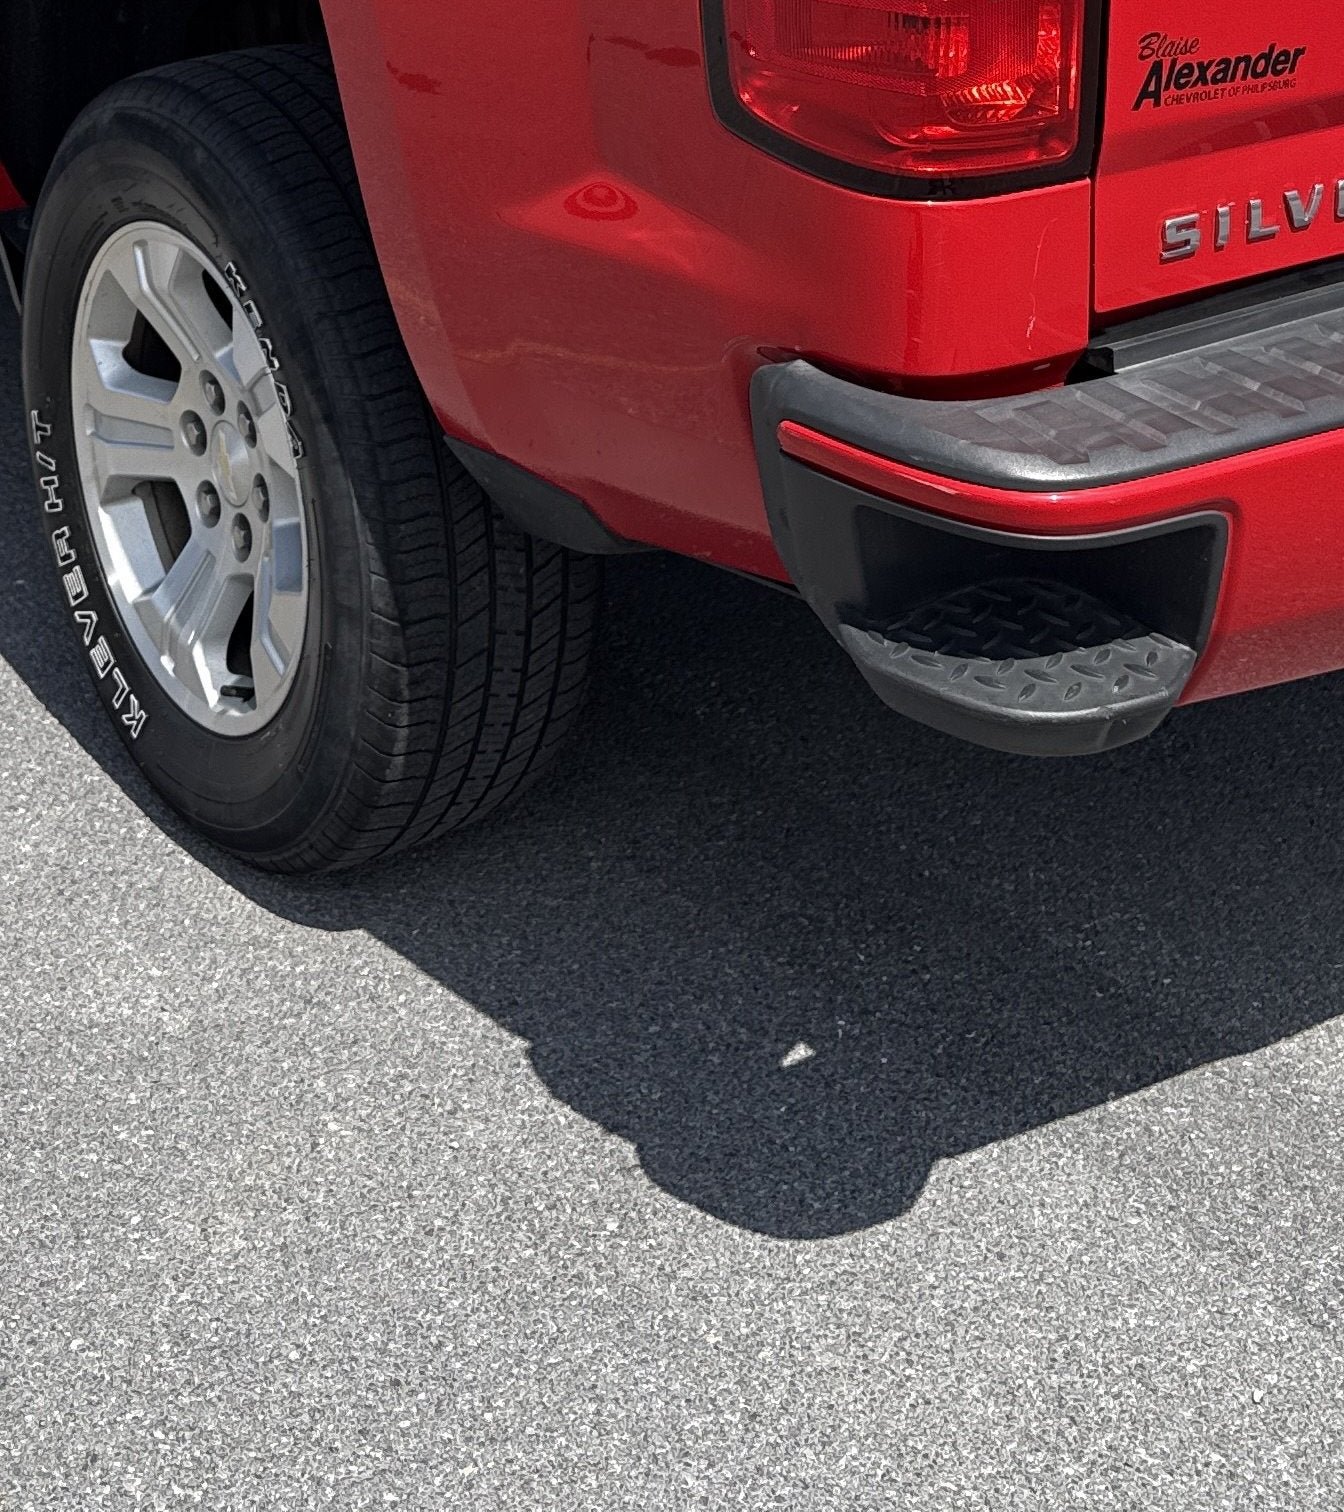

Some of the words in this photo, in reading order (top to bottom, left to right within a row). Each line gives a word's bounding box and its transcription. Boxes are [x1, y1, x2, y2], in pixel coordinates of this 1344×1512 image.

[1131, 42, 1306, 111] Alexander
[1138, 32, 1199, 60] Blaise
[1164, 88, 1226, 106] CHEVROLET
[1228, 87, 1241, 97] OF
[30, 409, 64, 513] H/T
[52, 526, 150, 739] KLEVER
